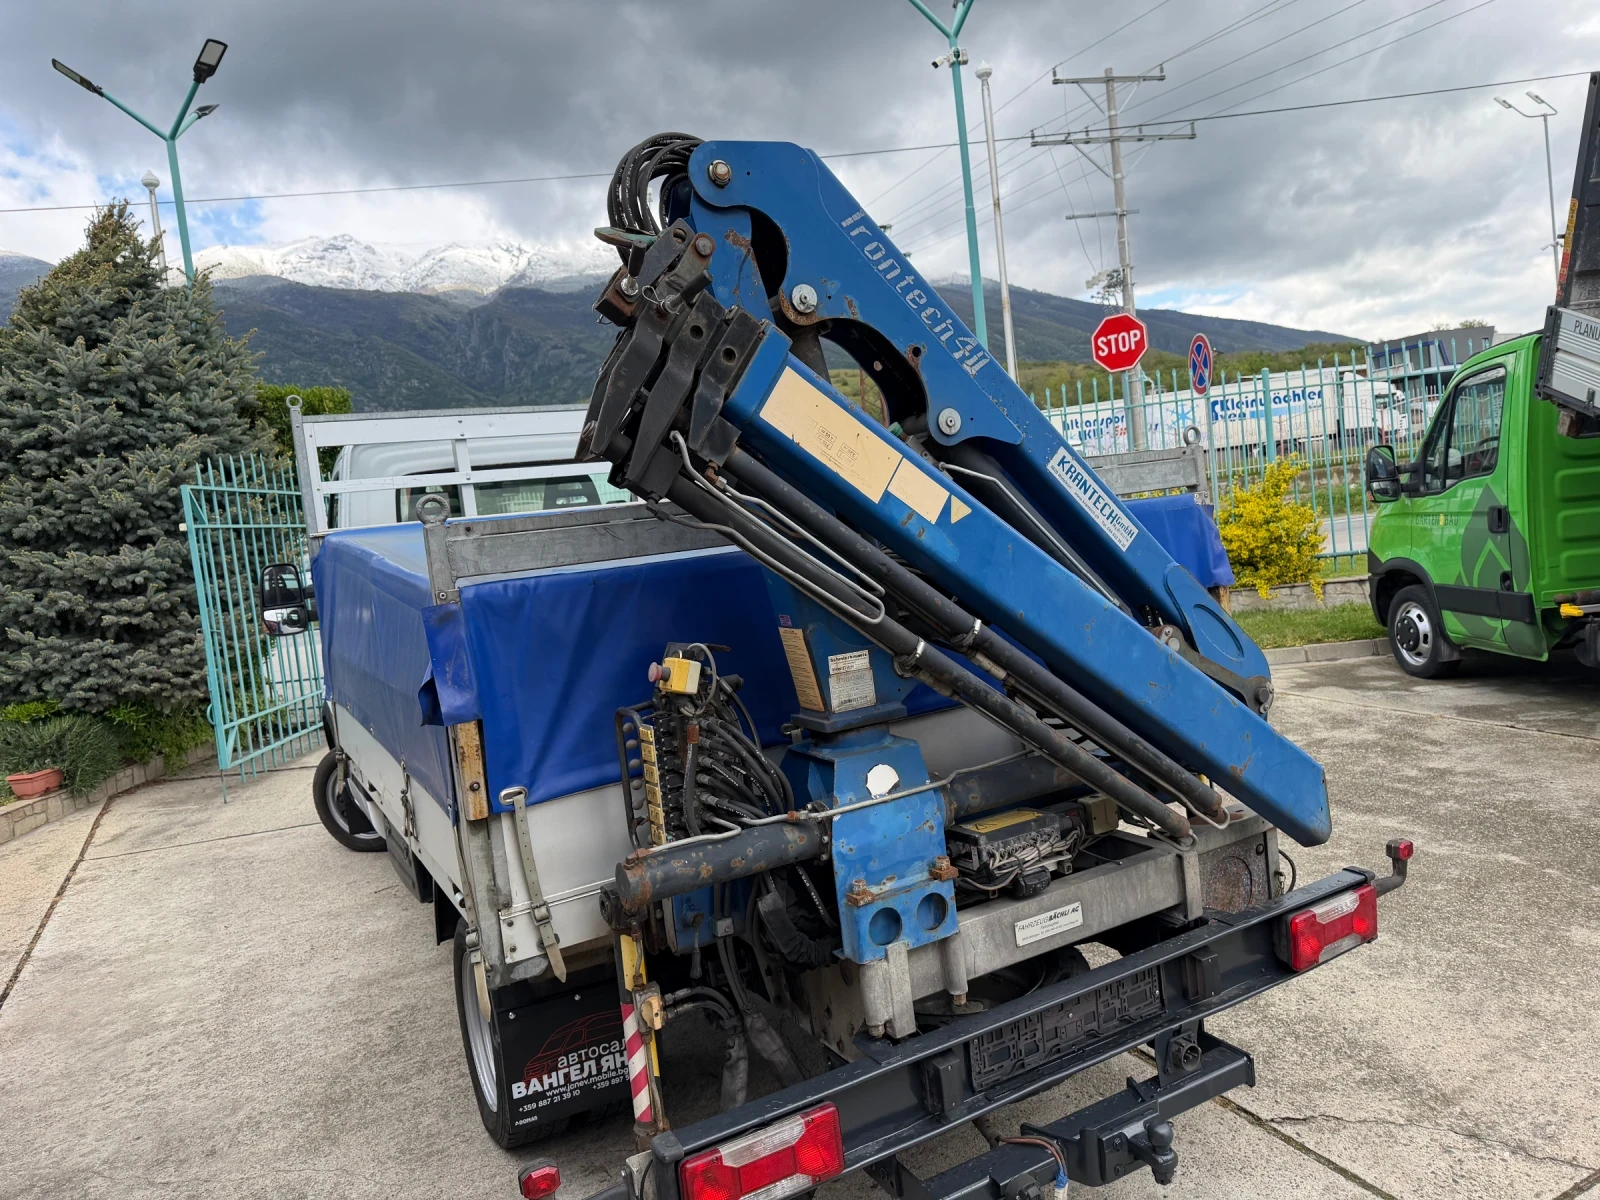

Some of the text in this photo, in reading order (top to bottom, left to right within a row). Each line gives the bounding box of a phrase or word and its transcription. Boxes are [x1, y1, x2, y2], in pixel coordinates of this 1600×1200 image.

[1096, 329, 1142, 357] STOP
[1057, 455, 1118, 524] KRANTECH
[1115, 516, 1135, 539] GmbH
[511, 1050, 629, 1100] ВАНГЕЛ ЯН
[518, 1102, 537, 1113] +359
[538, 1098, 551, 1107] 887
[553, 1095, 561, 1103] 21
[562, 1092, 572, 1100] 39
[592, 1080, 610, 1090] +359
[611, 1076, 624, 1085] 897
